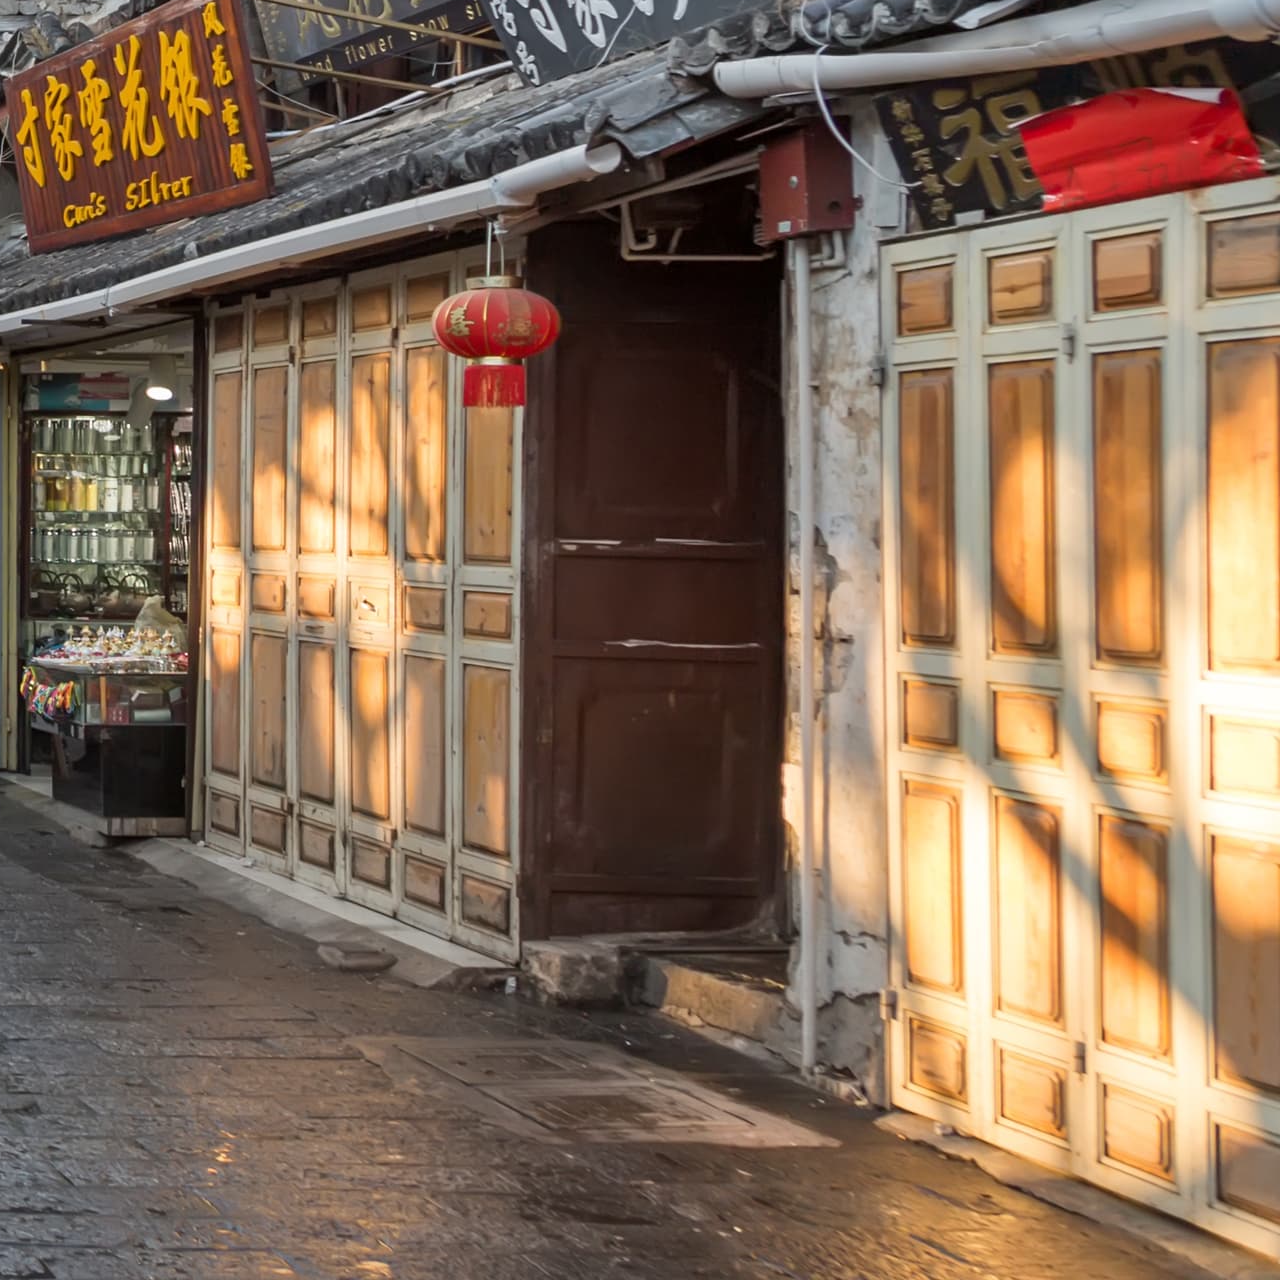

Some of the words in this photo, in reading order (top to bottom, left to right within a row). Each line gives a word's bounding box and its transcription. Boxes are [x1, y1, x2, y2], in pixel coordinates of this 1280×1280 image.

[344, 34, 394, 65] flower
[16, 28, 213, 189] 寸家雪花银
